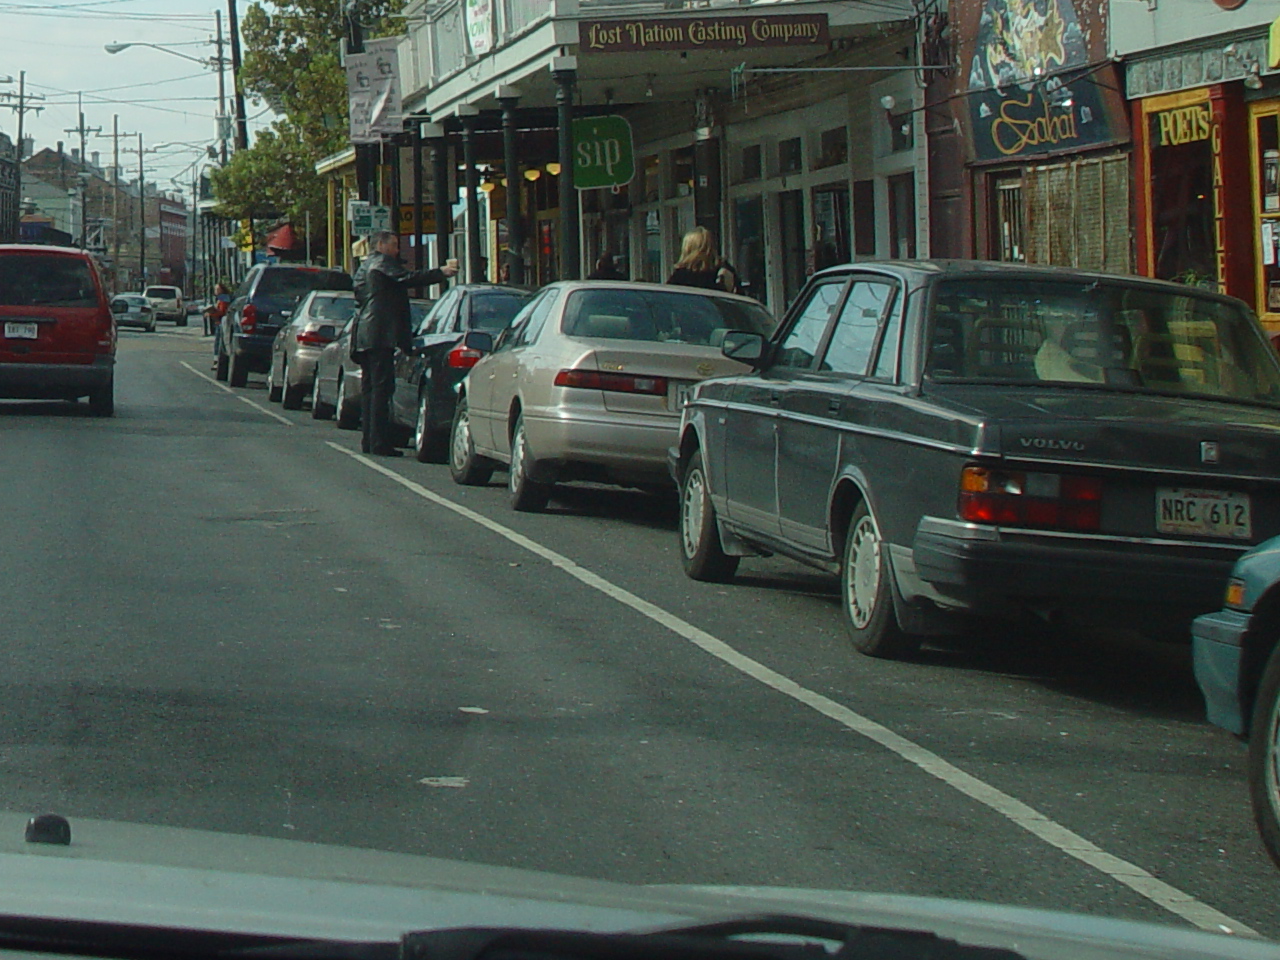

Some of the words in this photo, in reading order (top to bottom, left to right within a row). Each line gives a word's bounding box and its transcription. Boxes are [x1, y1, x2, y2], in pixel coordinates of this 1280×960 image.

[589, 23, 621, 49] Lost
[625, 22, 683, 46] Nation
[687, 21, 747, 45] Casting
[751, 18, 821, 42] Company
[577, 127, 620, 176] sip
[1019, 438, 1085, 451] VOLVO
[1161, 498, 1197, 522] NRC
[1209, 503, 1246, 527] 612
